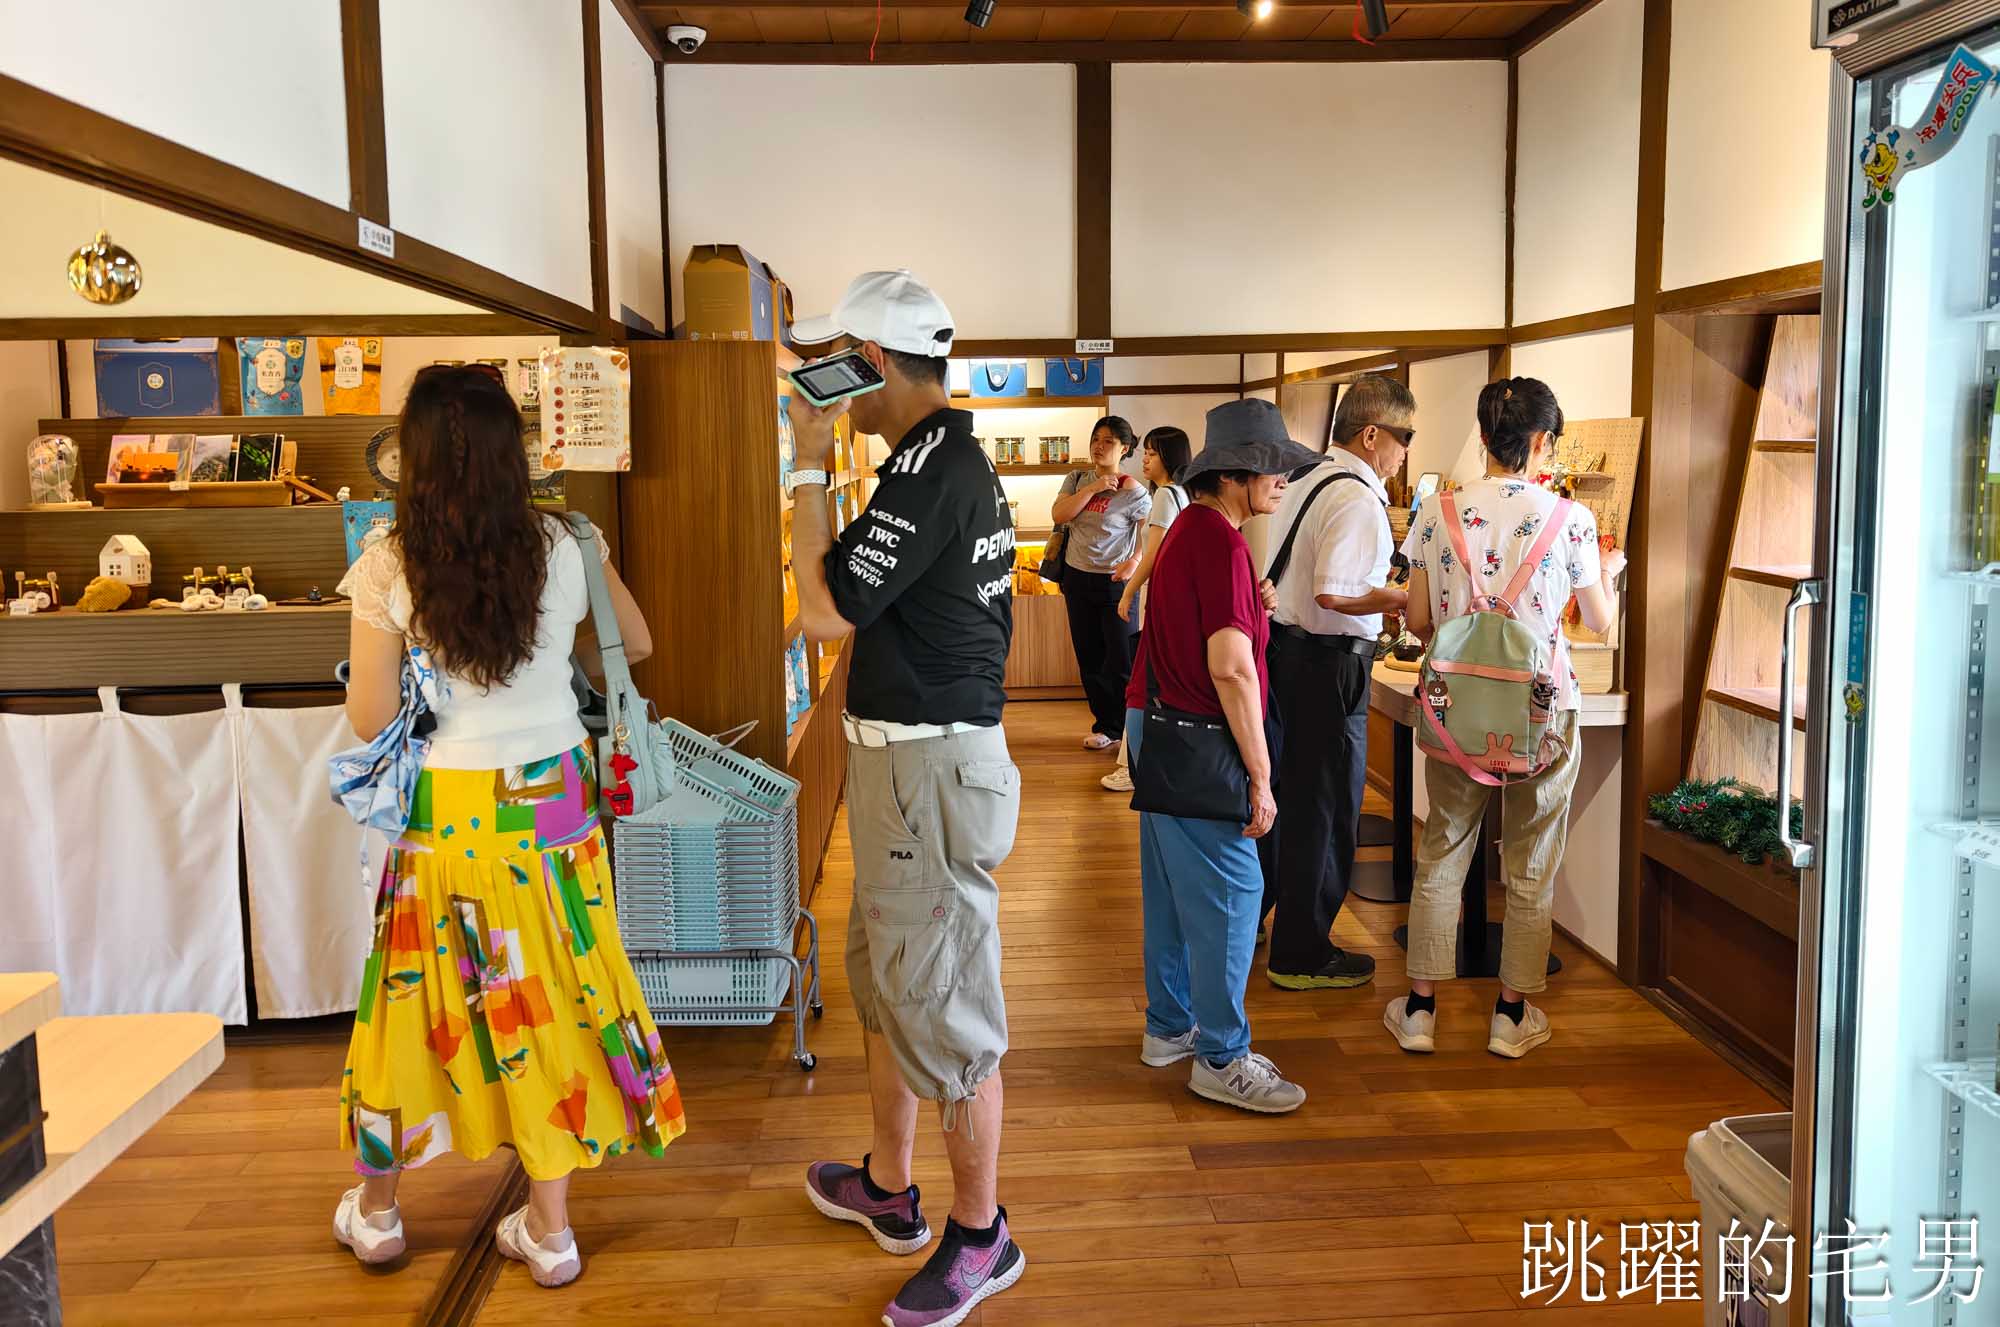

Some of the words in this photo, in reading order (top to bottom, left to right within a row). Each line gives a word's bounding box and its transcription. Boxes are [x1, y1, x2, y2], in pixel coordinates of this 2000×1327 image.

[1951, 80, 1985, 132] COOL
[875, 510, 917, 535] SOLERA
[866, 525, 901, 549] IWC
[848, 560, 885, 588] ONVOY
[850, 554, 884, 577] MARRIOTT
[890, 851, 914, 860] FILA
[1224, 1072, 1255, 1096] N
